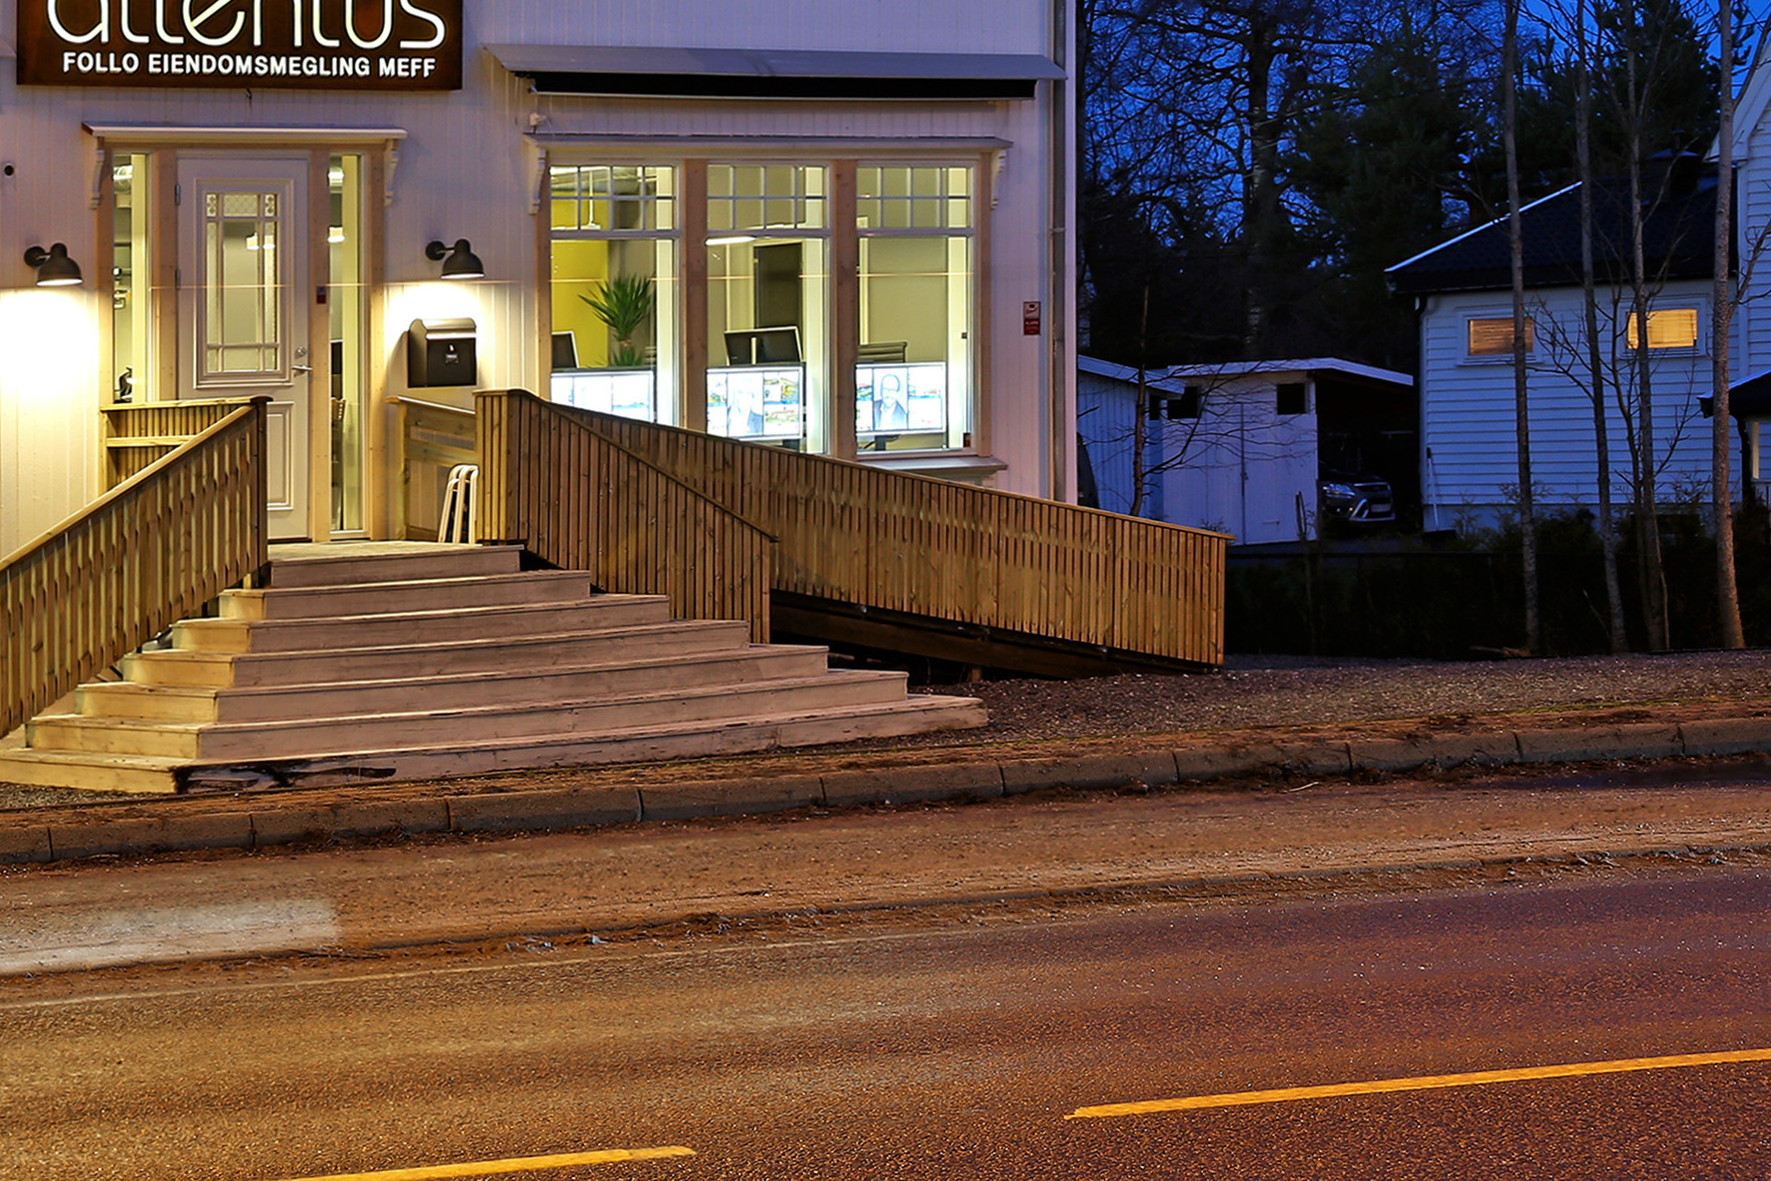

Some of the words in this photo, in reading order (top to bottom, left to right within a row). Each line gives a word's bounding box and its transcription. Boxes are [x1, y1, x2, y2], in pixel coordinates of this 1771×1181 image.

[63, 51, 139, 74] FOLLO
[148, 53, 371, 77] EIENDOMSMEGLING
[379, 57, 437, 78] MEFF
